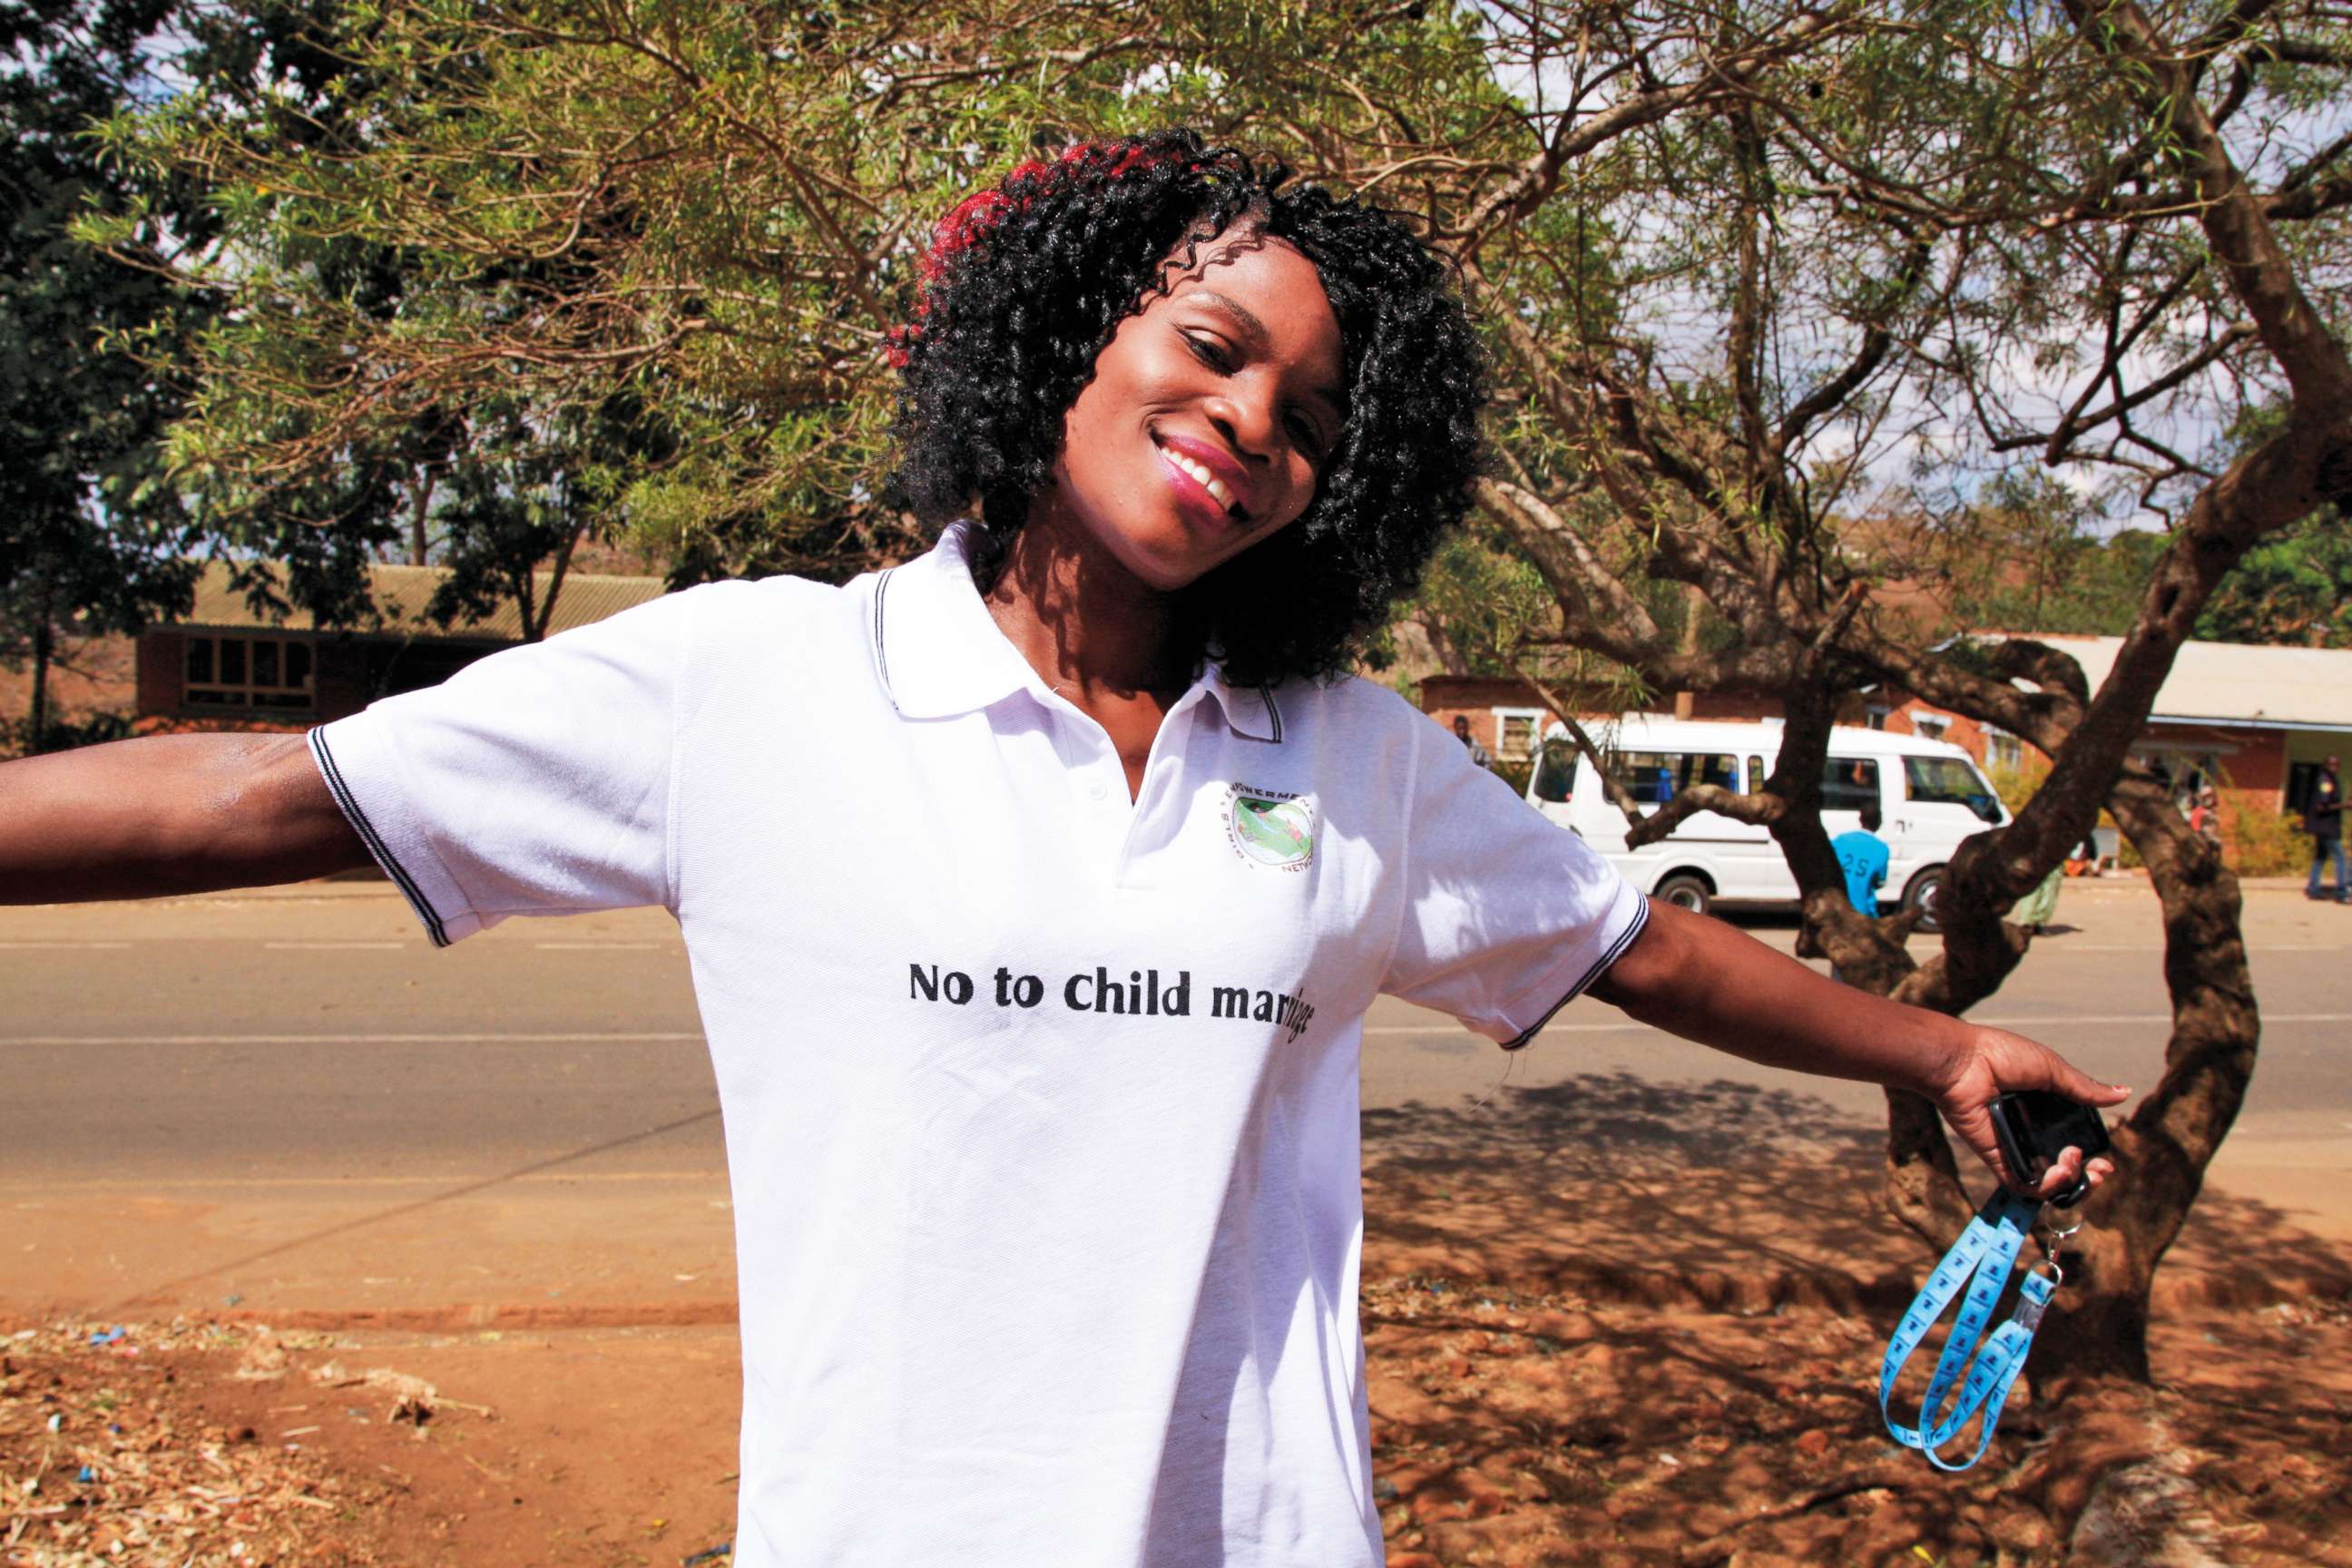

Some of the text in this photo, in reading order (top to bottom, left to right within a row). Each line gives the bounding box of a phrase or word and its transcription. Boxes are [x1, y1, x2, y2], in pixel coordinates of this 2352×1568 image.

[1843, 853, 1870, 877] 25
[910, 964, 975, 1005] No
[994, 967, 1044, 1008] to
